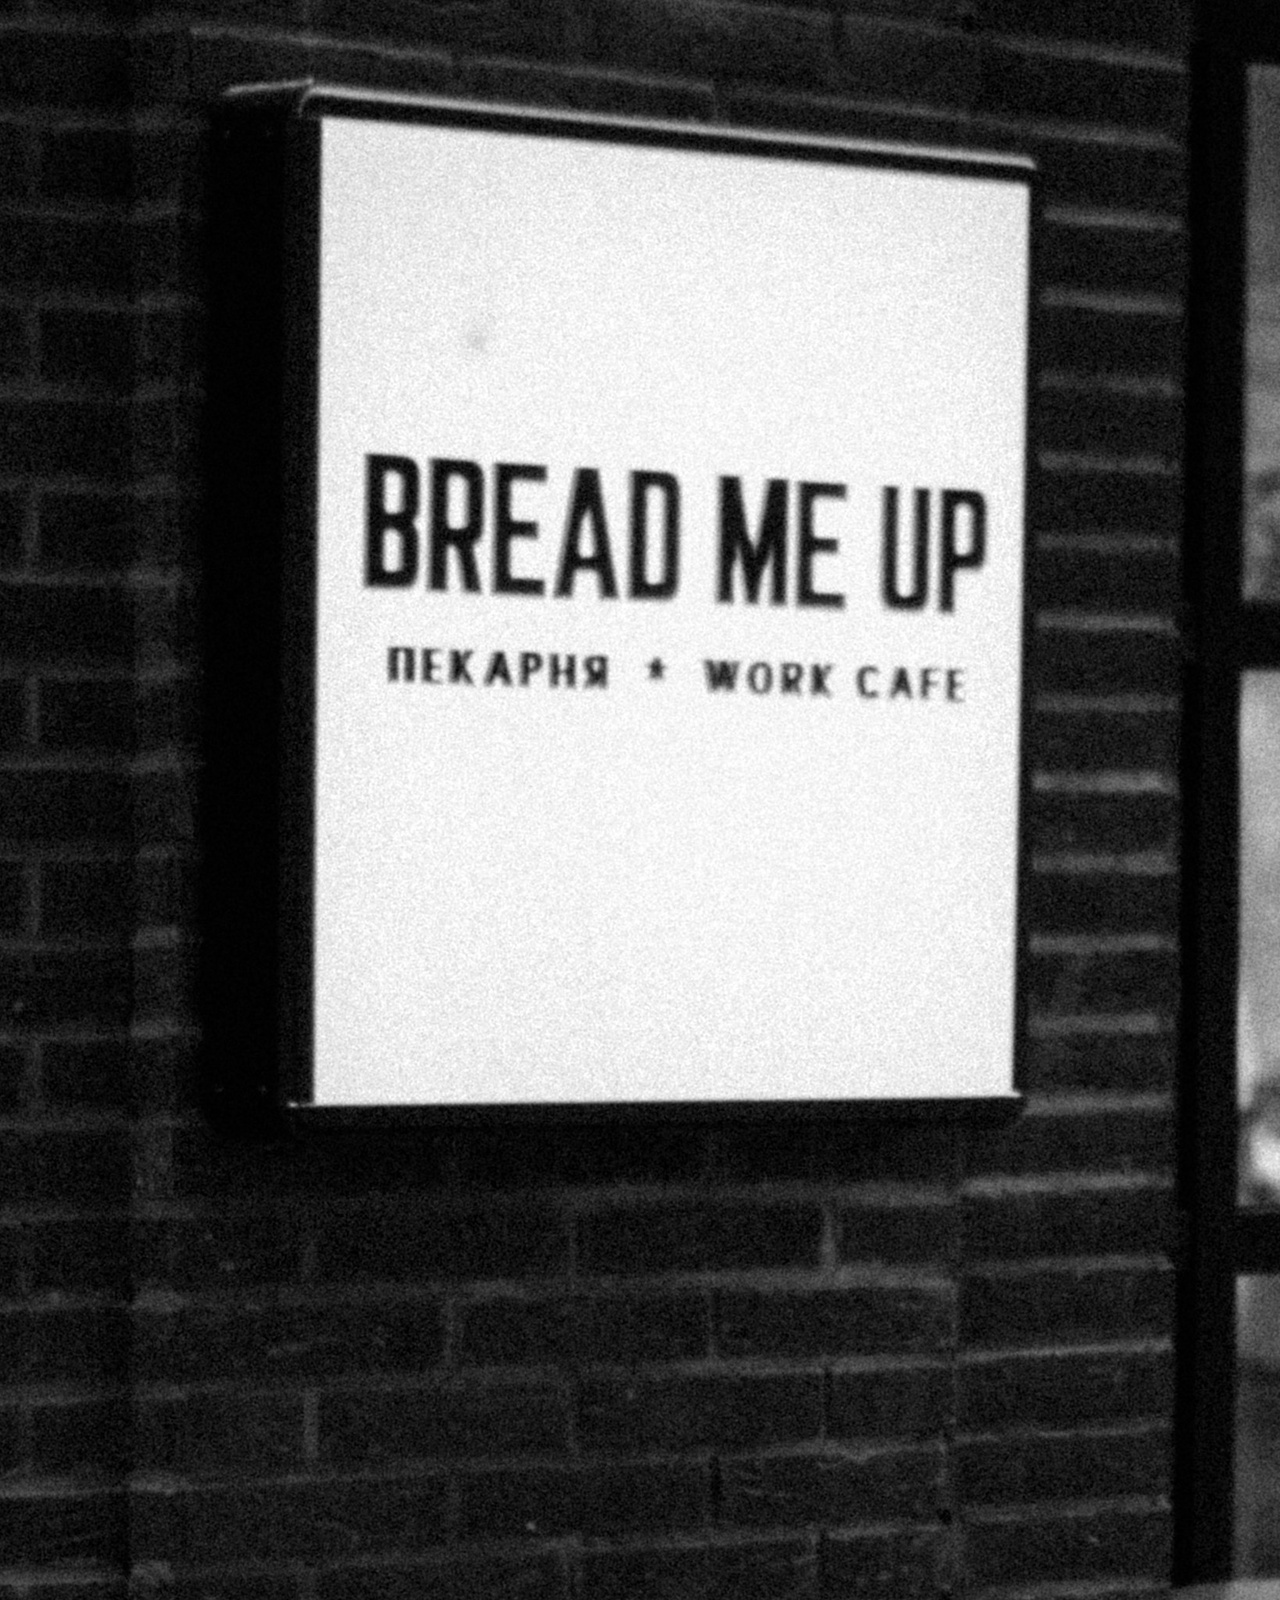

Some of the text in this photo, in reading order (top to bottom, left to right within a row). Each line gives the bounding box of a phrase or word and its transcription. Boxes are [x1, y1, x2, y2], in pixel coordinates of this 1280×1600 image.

[363, 452, 989, 614] BREAD ME UP
[386, 645, 609, 688] ПЕКАРНЯ
[703, 658, 967, 701] WORK CAFE
